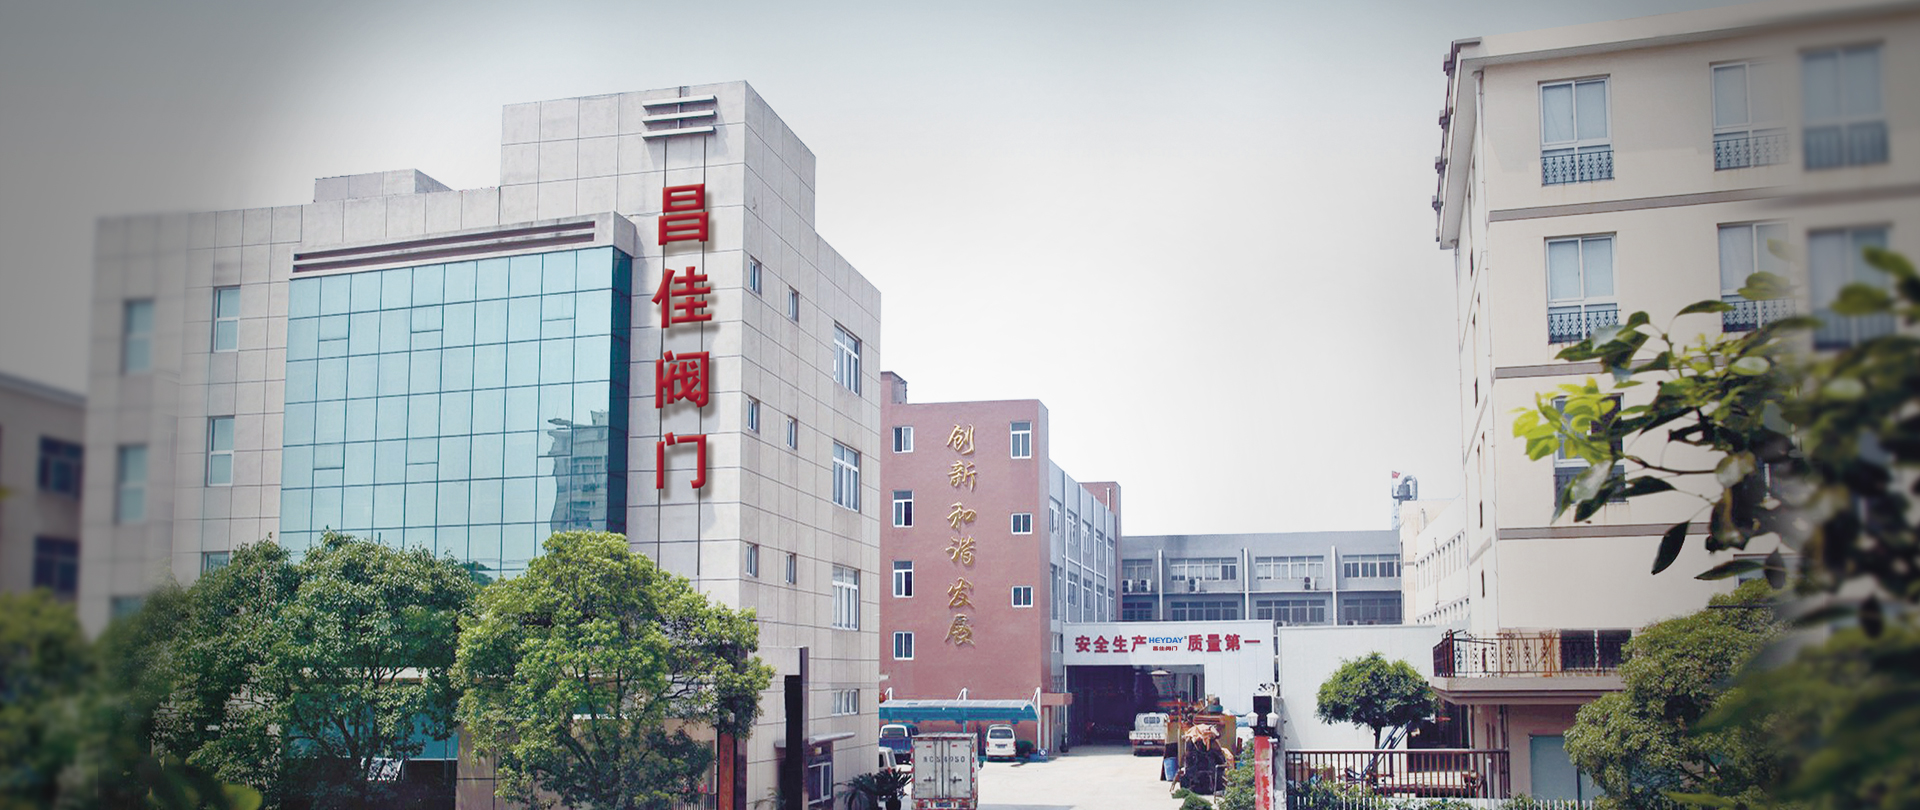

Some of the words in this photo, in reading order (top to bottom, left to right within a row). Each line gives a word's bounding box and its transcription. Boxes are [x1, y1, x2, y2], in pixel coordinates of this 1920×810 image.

[651, 183, 713, 489] 昌佳阀门
[946, 424, 977, 647] 创新和谐发展
[1075, 635, 1147, 653] 安全生产
[1188, 634, 1261, 652] 质量第一
